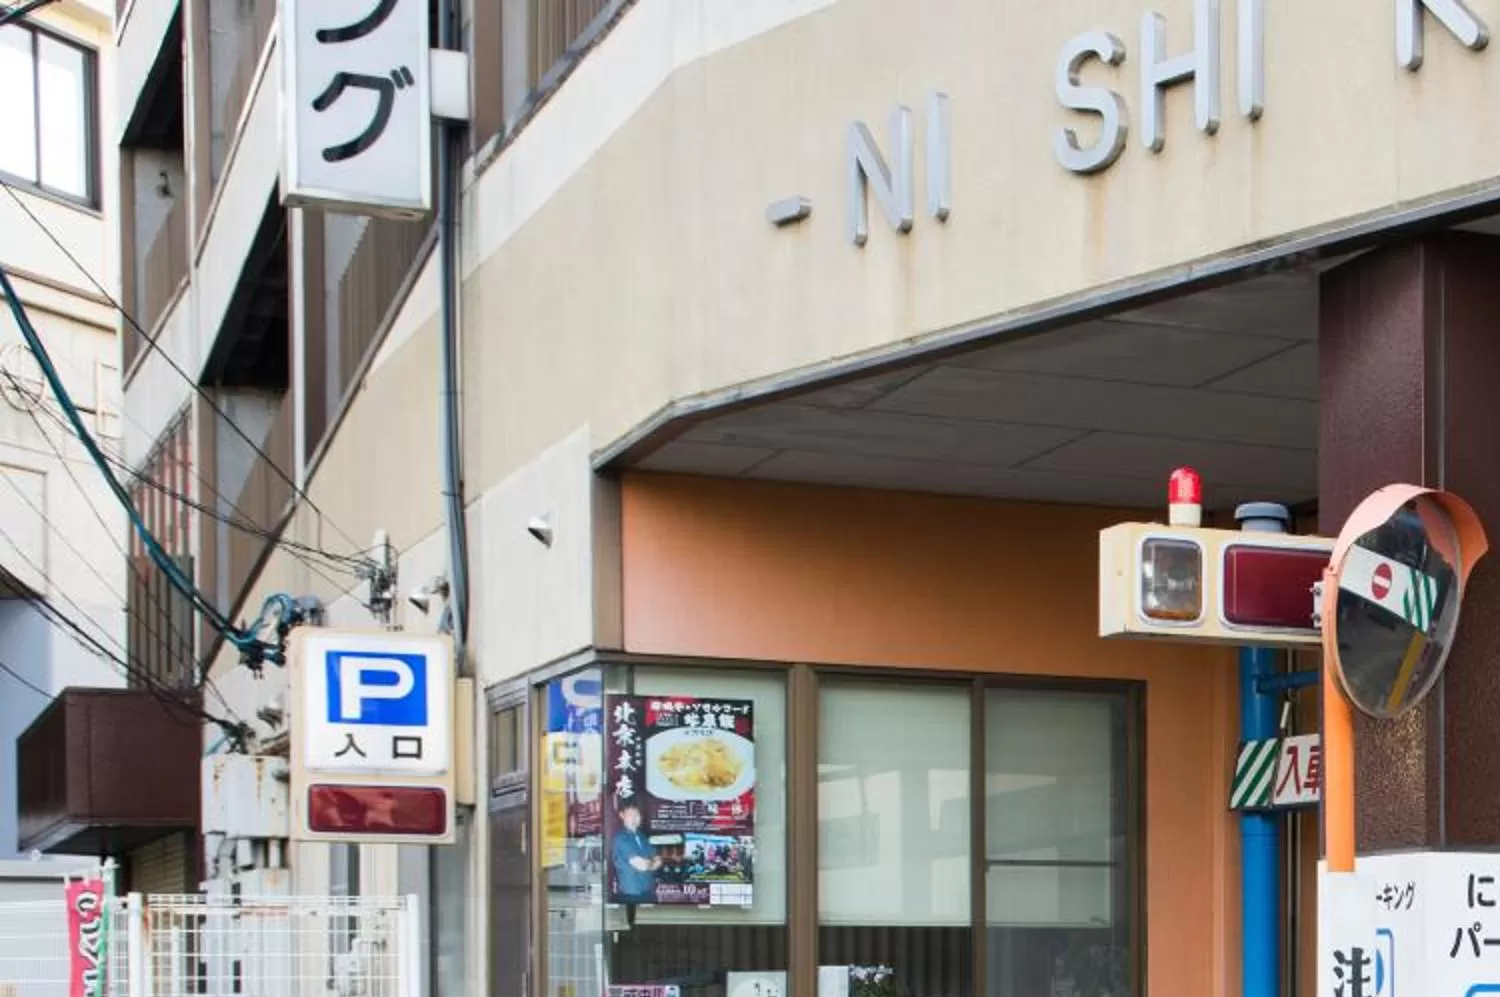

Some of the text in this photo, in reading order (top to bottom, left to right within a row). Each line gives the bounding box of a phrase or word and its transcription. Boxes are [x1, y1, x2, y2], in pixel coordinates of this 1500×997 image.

[846, 91, 951, 248] NI
[1054, 0, 1266, 176] SHI
[339, 656, 415, 720] P
[334, 733, 423, 759] 入口
[1375, 881, 1415, 911] ーキング
